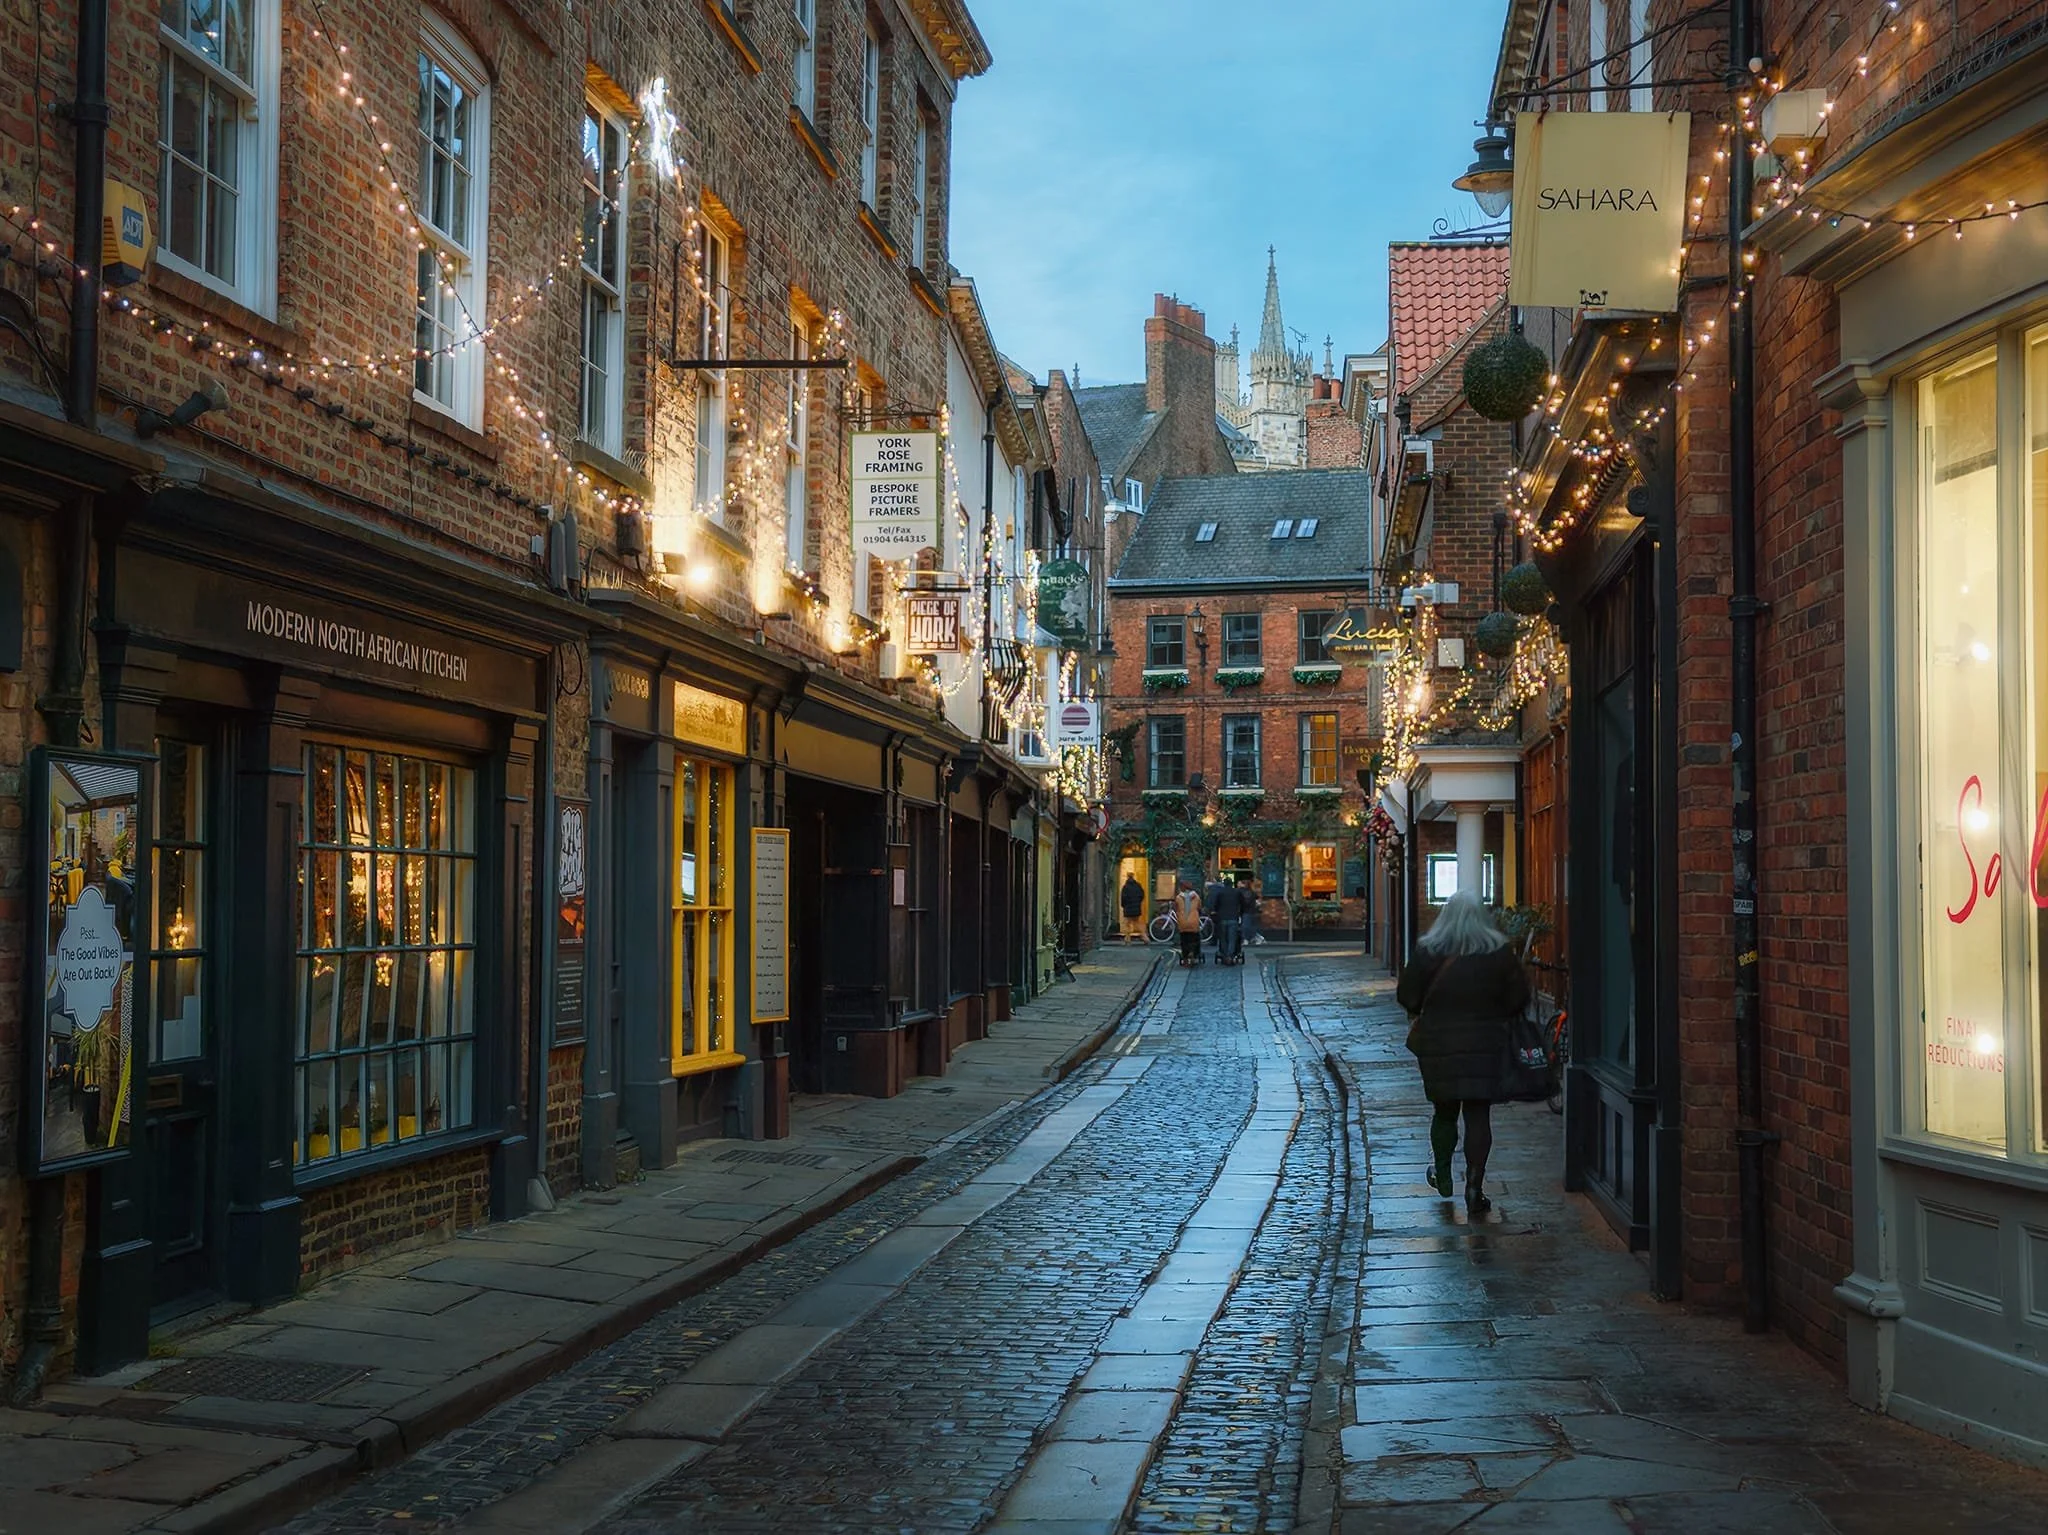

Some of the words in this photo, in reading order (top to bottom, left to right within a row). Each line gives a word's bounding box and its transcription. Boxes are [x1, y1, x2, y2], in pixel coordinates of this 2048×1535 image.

[1537, 188, 1658, 211] SAHARA
[123, 216, 144, 240] ADT
[877, 438, 911, 448] YORK
[878, 451, 910, 460] ROSE
[865, 462, 923, 472] FRAMING
[870, 484, 919, 493] BESPOKE
[871, 496, 918, 505] PICTURE
[869, 507, 920, 516] FRAMERS
[878, 526, 911, 535] Tel/Fax
[893, 535, 927, 543] 644315
[910, 600, 940, 616] PIECE
[943, 600, 957, 616] OF
[910, 616, 956, 643] YORK
[1327, 618, 1405, 640] Lucia
[247, 601, 315, 645] MODERN
[318, 619, 365, 658] NORTH
[367, 633, 419, 672] AFRICAN
[421, 648, 468, 682] KITCHEN
[61, 948, 75, 961] The
[76, 947, 97, 960] Good
[98, 945, 119, 960] Vibes
[63, 968, 77, 981] Are
[78, 967, 93, 980] Out
[94, 965, 115, 979] Back!
